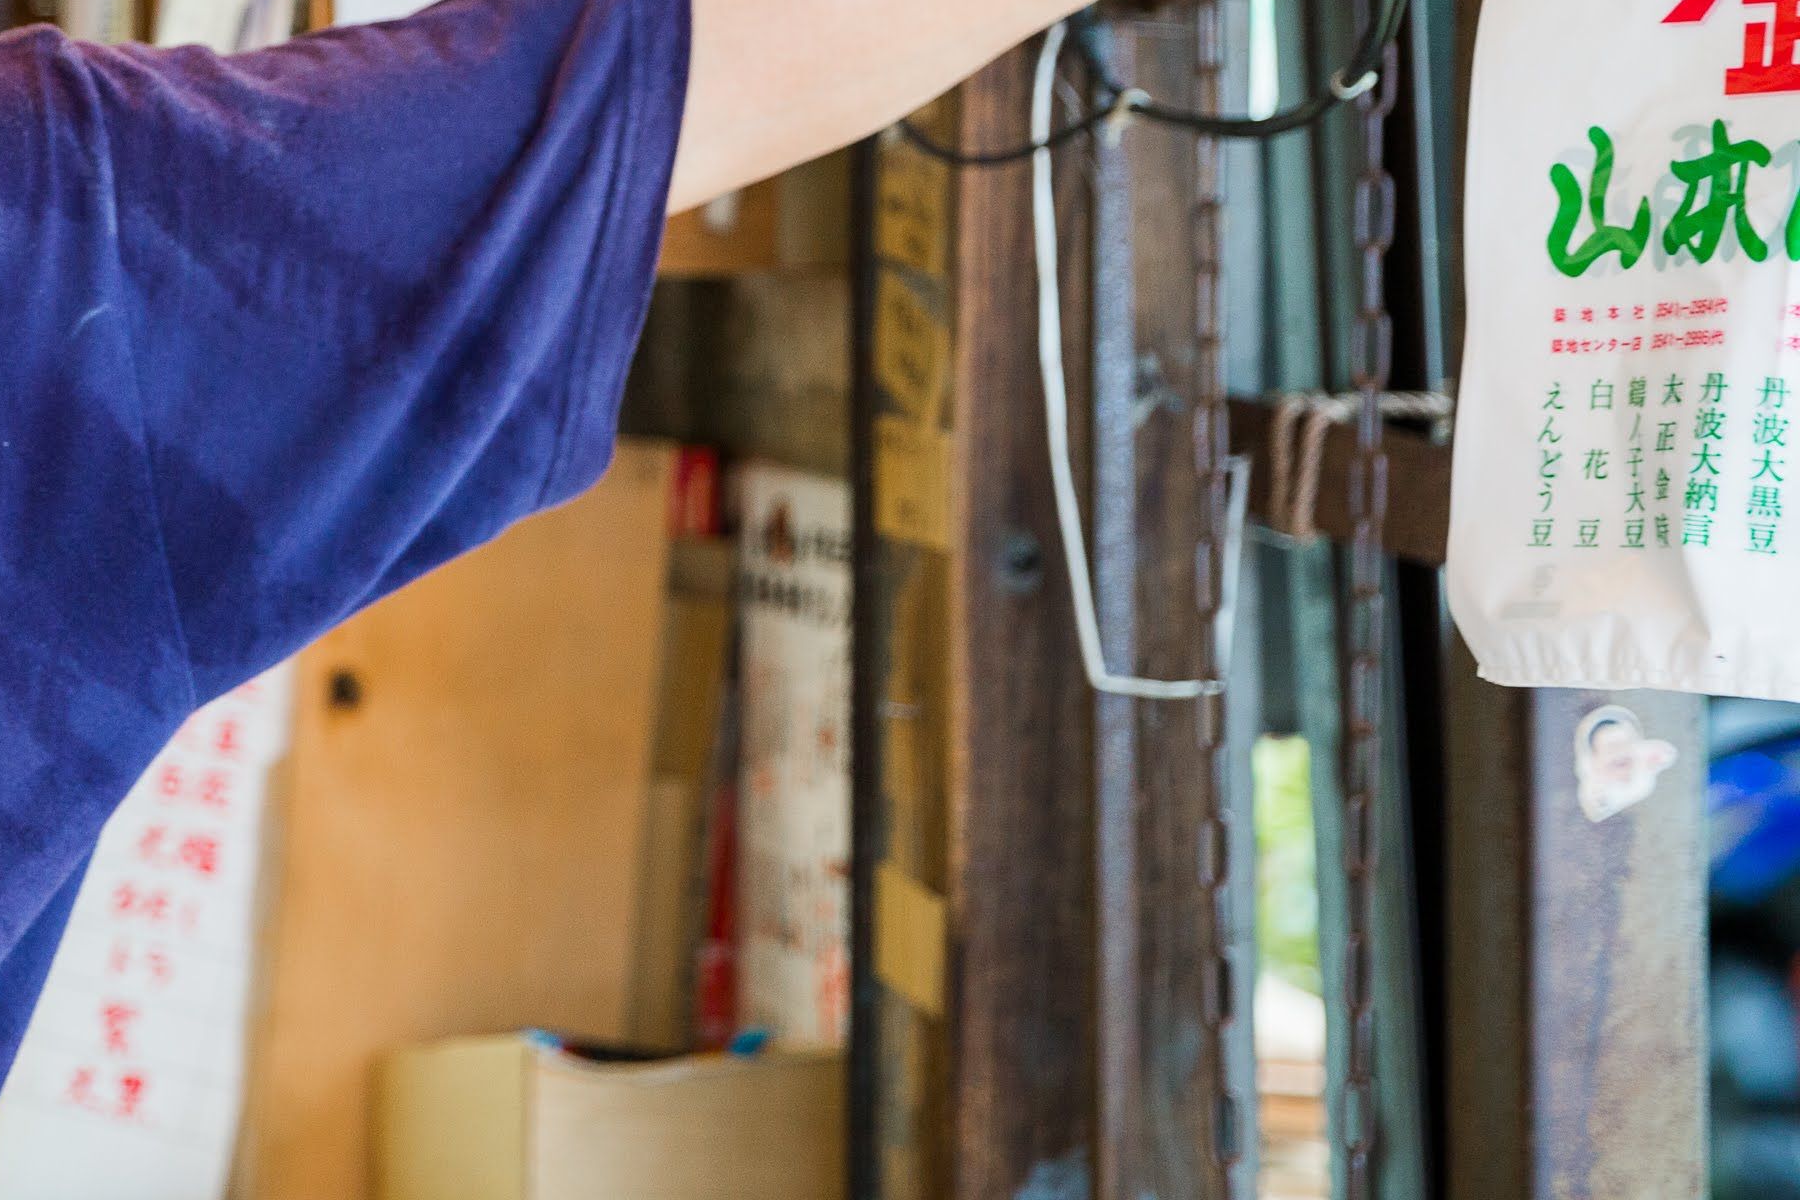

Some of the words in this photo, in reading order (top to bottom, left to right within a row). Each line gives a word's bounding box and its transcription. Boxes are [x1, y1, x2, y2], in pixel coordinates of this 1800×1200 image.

[1546, 118, 1800, 278] 山本
[1525, 380, 1566, 548] えんどう豆
[1572, 378, 1615, 548] 白花豆
[1682, 372, 1729, 547] 丹波大納言
[1743, 376, 1791, 554] 丹波大黒豆
